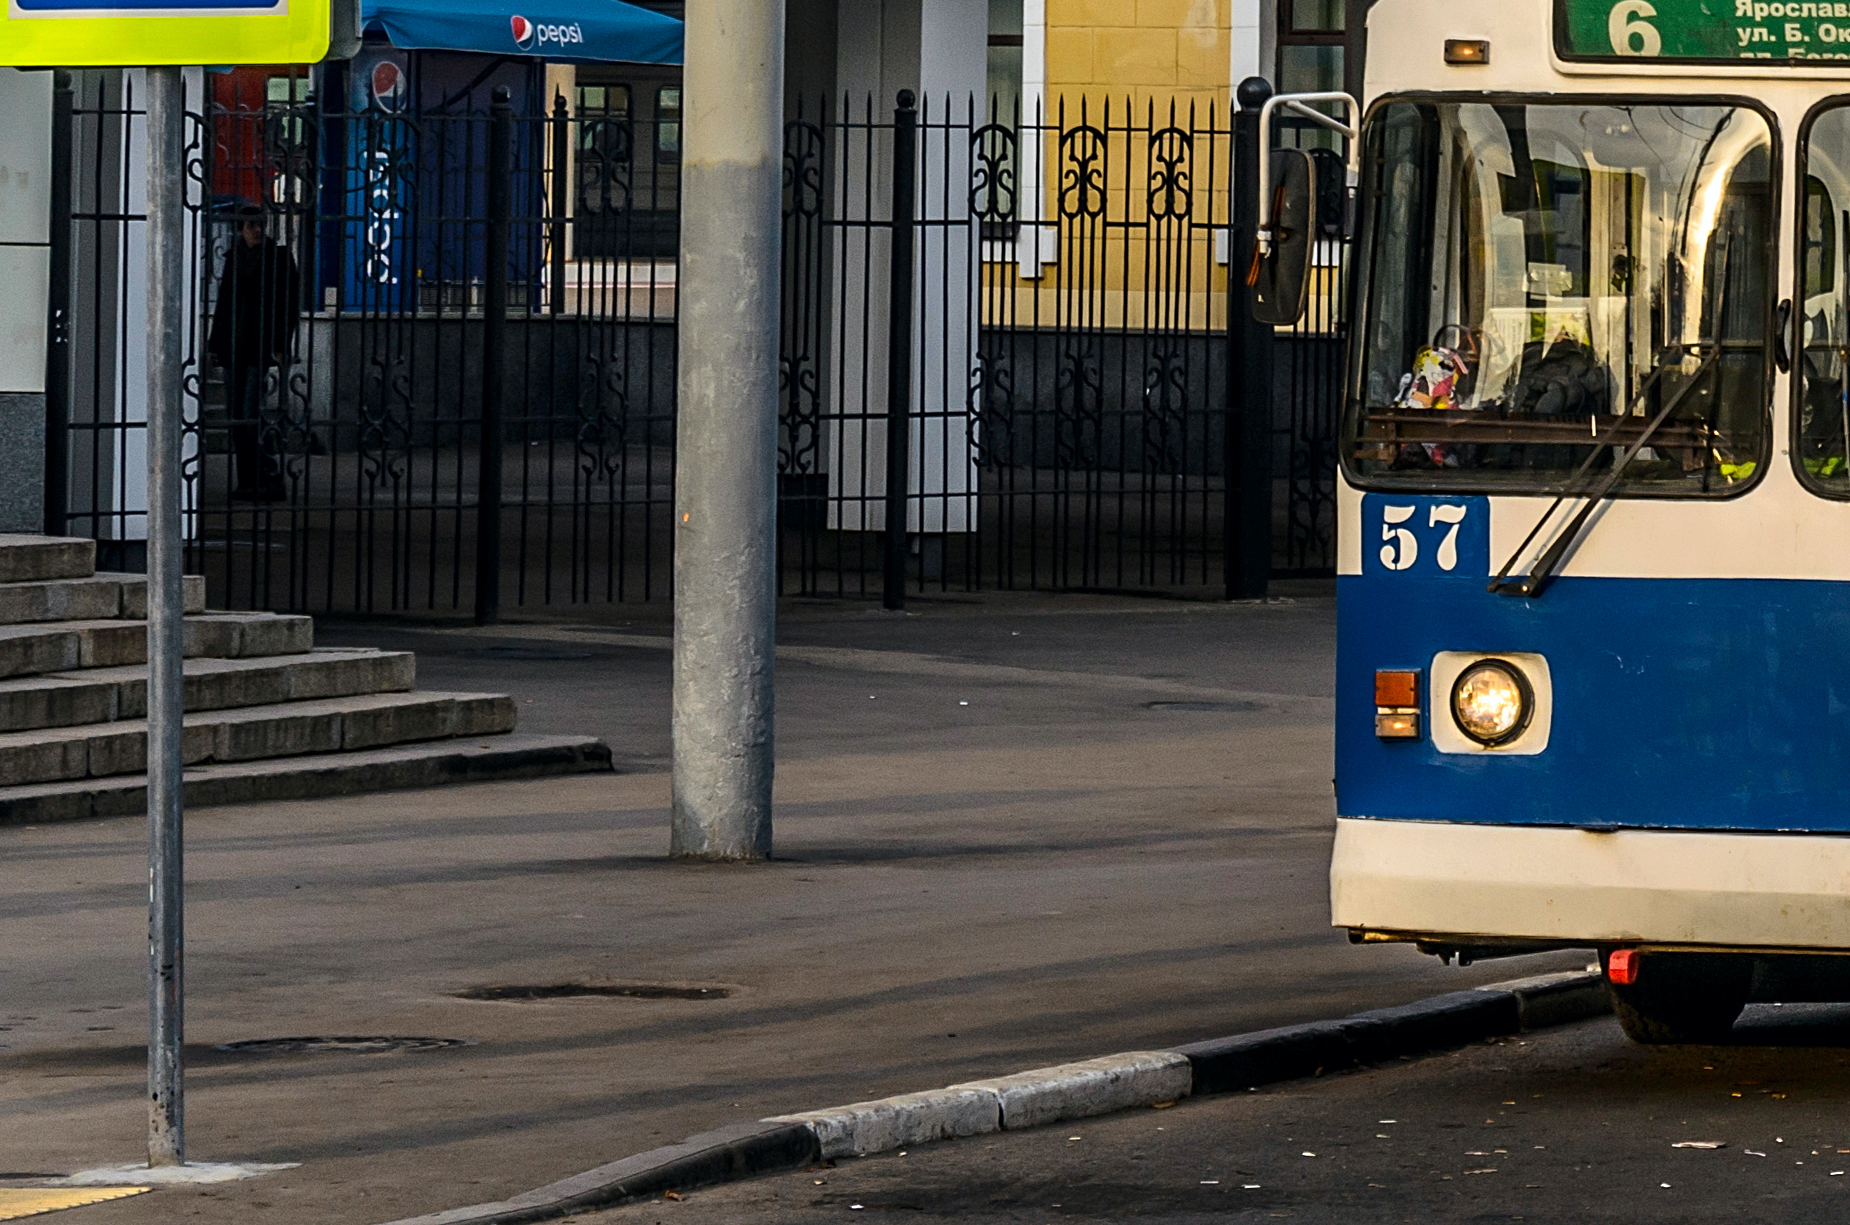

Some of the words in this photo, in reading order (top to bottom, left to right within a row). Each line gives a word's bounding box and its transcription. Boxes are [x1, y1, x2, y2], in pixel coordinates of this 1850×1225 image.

[537, 22, 584, 48] pepsi
[1736, 26, 1776, 46] ул.
[1784, 23, 1810, 43] Б.
[1379, 503, 1468, 572] 57
